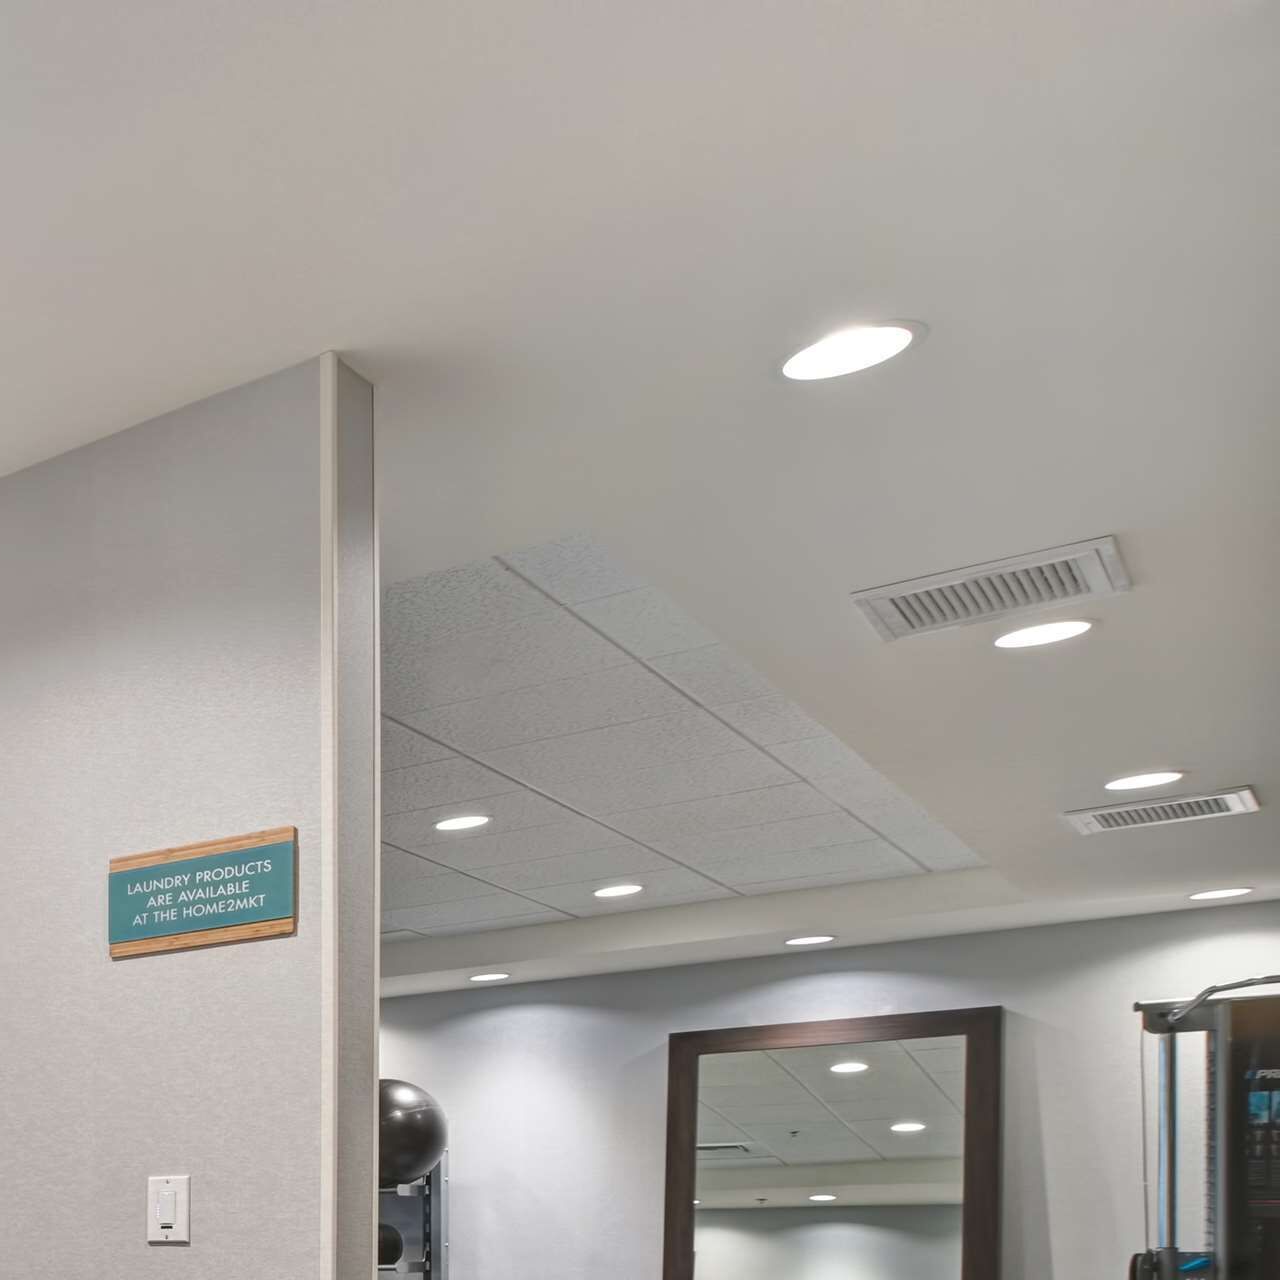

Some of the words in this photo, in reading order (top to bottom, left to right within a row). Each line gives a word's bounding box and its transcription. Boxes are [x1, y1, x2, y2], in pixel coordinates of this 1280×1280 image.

[127, 874, 191, 895] LAUNDRY
[196, 859, 272, 884] PRODUCTS
[132, 913, 148, 927] AT
[153, 908, 177, 923] THE
[183, 894, 266, 919] HOME2MKT
[146, 892, 173, 908] ARE
[178, 880, 250, 903] AVAILABLE
